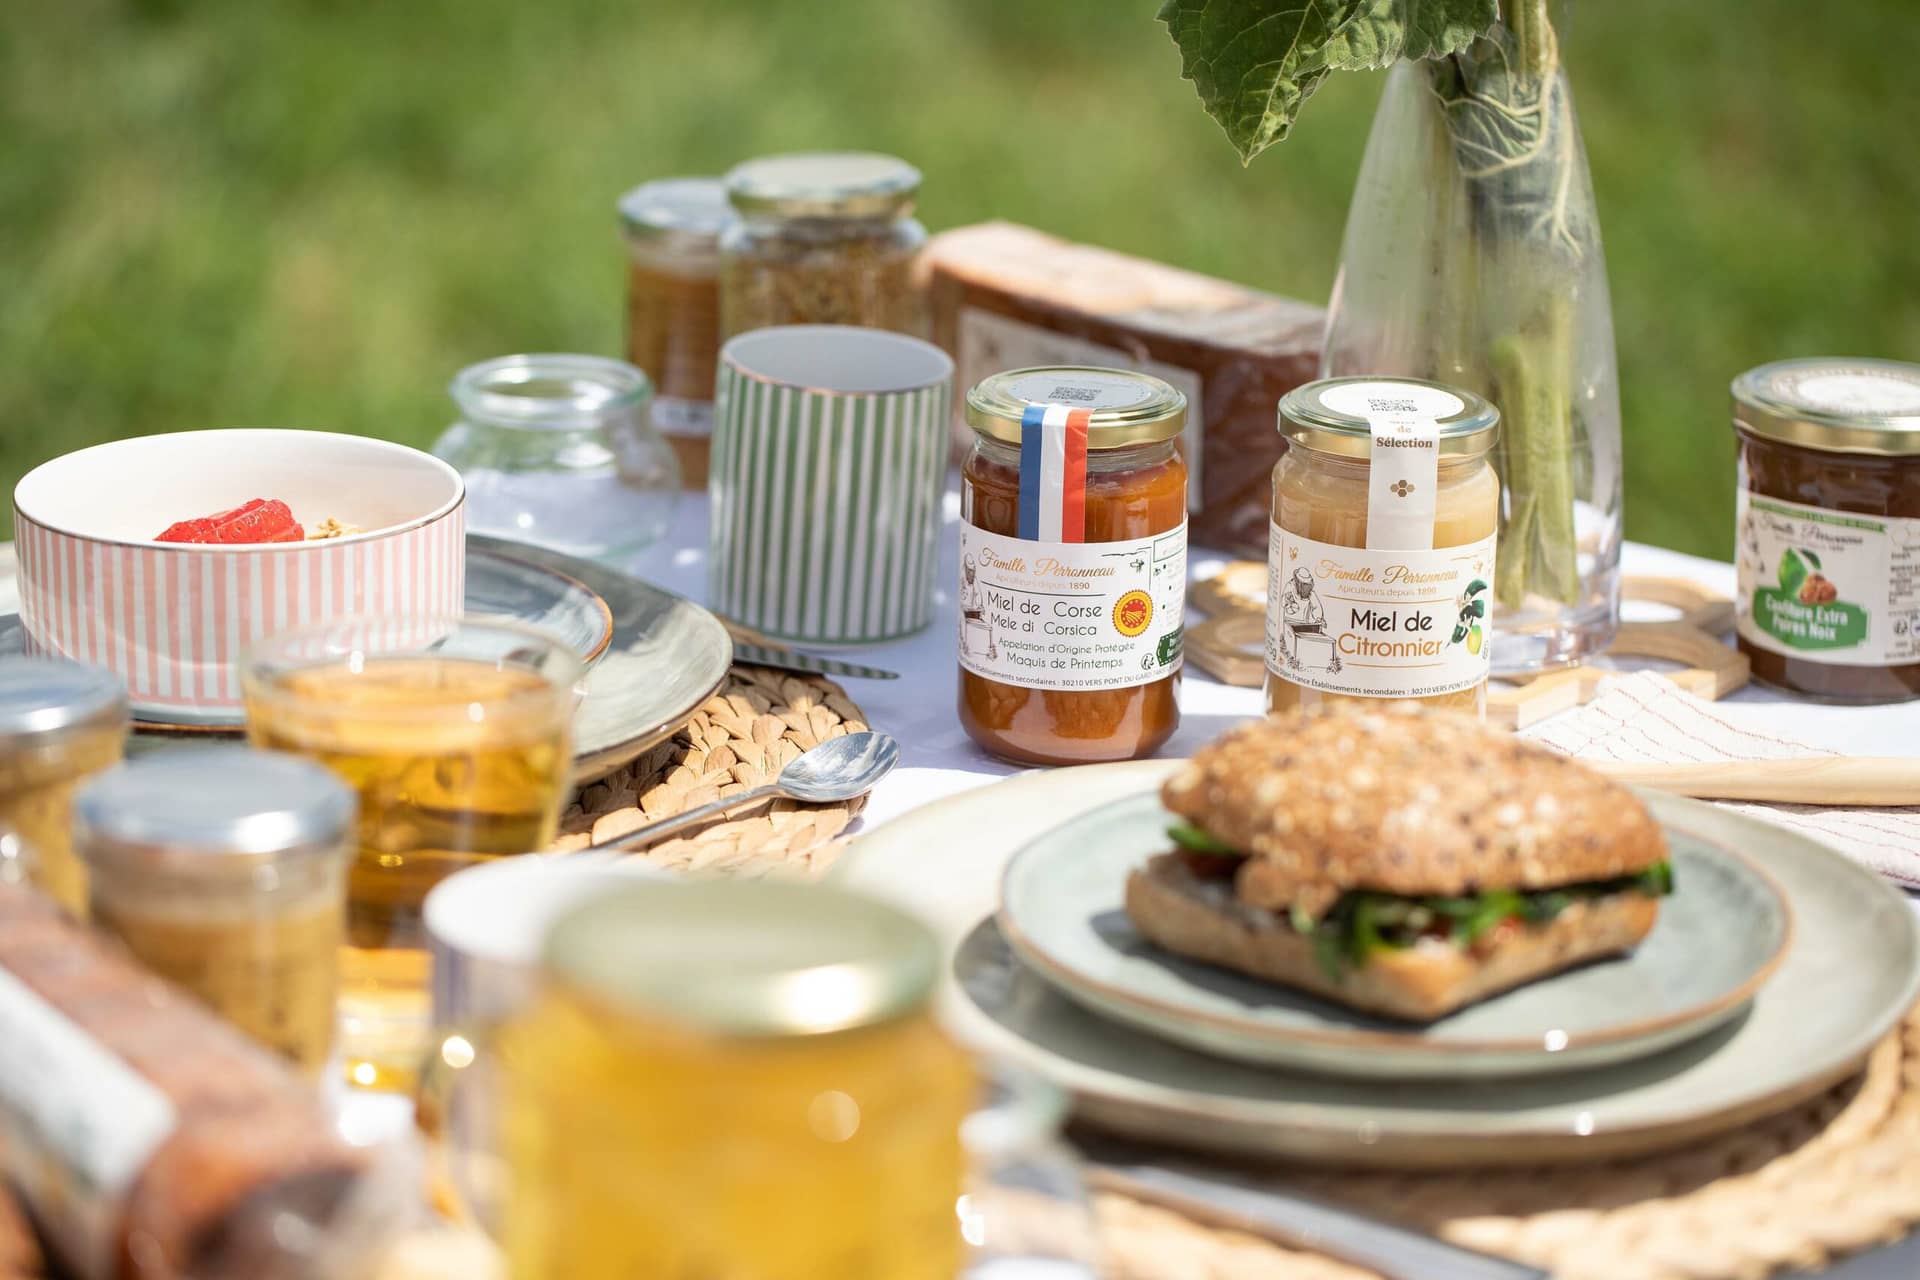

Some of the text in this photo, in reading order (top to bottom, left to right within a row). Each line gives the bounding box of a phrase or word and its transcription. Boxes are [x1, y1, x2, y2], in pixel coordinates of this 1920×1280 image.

[1376, 436, 1433, 448] Sélection
[979, 547, 1116, 577] Famille Perronneau
[1314, 559, 1459, 585] Famille Perronneau
[1069, 582, 1090, 590] 1890
[1337, 584, 1386, 596] Apiculteurs
[1418, 587, 1437, 595] 1890
[987, 591, 1102, 618] Miel de Corse
[990, 612, 1097, 636] Mele di Corsica
[1350, 608, 1433, 632] Miel de
[1816, 605, 1848, 626] Extra
[998, 637, 1045, 652] Appelation
[1048, 644, 1092, 655] d'Origine
[1338, 632, 1444, 657] Citronnier
[1006, 652, 1123, 669] Maquis de Printemps
[1015, 676, 1056, 686] secondaires
[1103, 677, 1123, 685] PONT
[1363, 687, 1405, 696] secondaires
[1411, 687, 1432, 695] 30210
[1432, 685, 1447, 693] VERS
